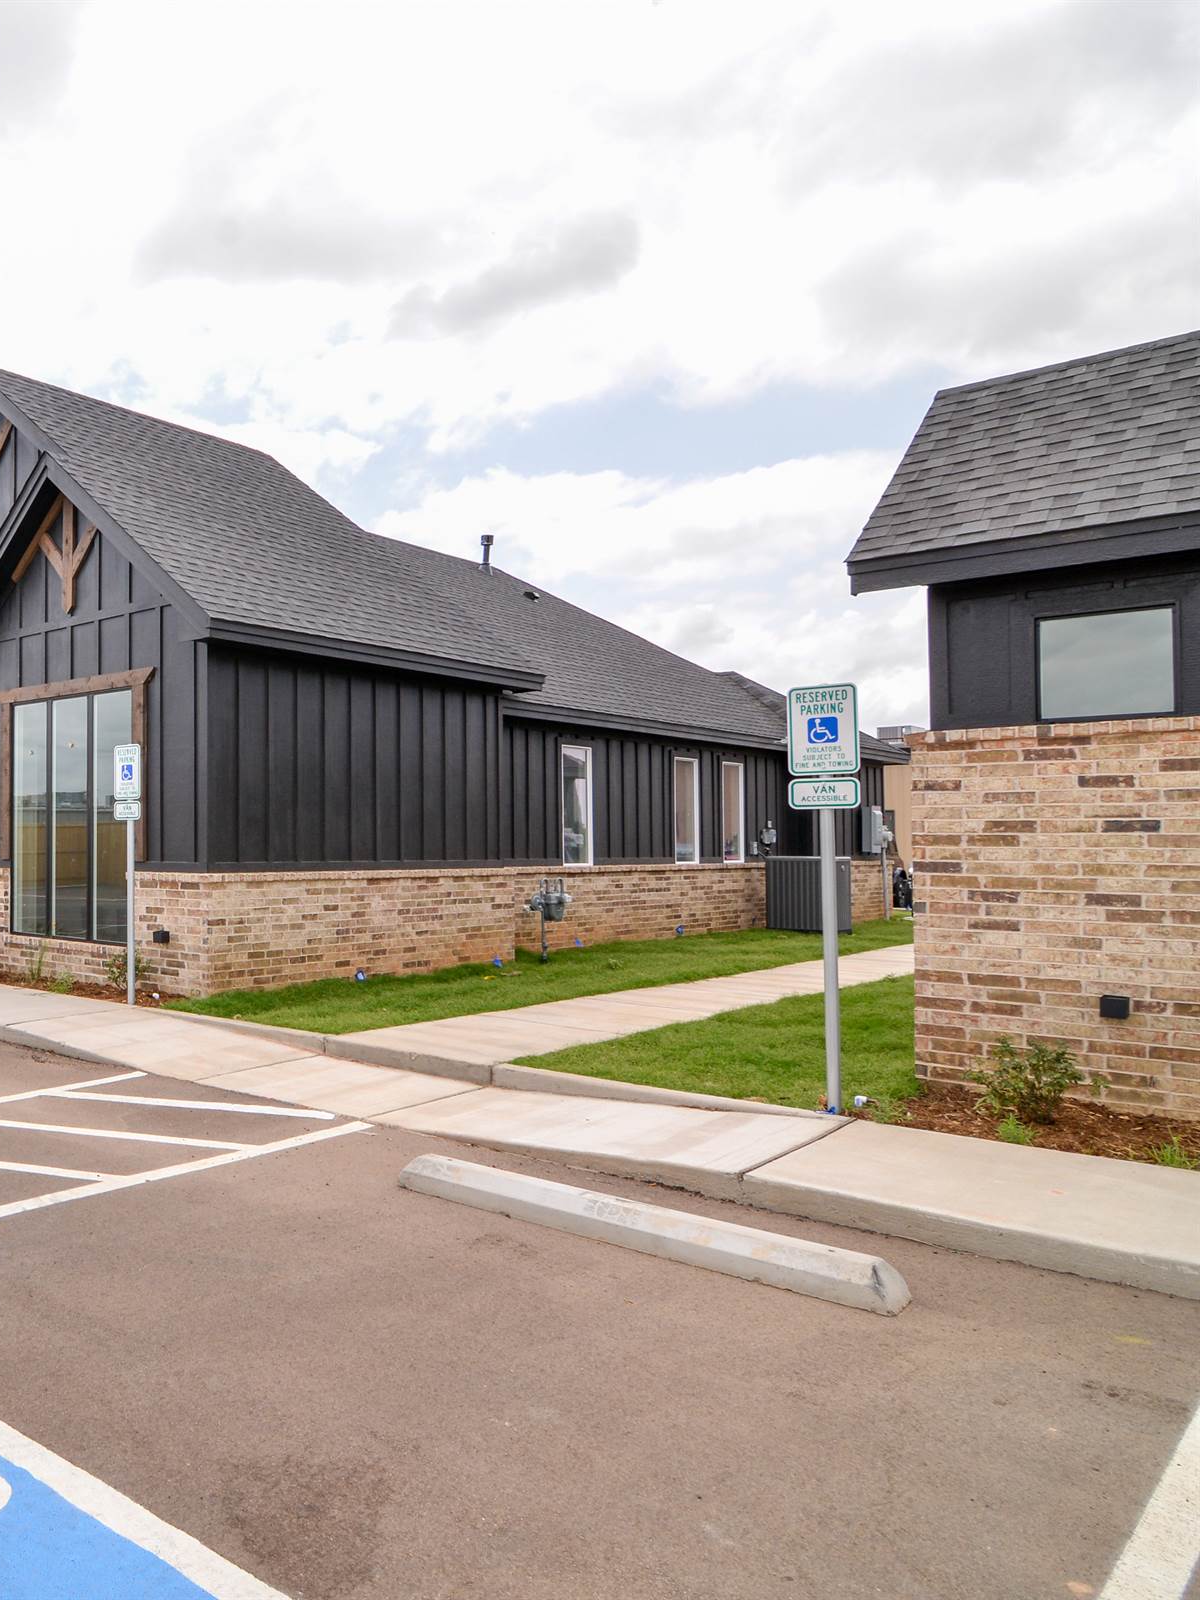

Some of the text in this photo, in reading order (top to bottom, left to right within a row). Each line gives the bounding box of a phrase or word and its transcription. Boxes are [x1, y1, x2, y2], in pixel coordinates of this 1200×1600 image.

[796, 690, 848, 704] RESERVED
[800, 702, 844, 716] PARKING
[806, 745, 842, 753] VIOLATORS
[802, 753, 832, 761] SUBJECT
[795, 761, 809, 769] FINE
[828, 760, 854, 768] TOWING
[812, 785, 836, 794] VAN
[801, 794, 848, 803] ACCESSIBLE
